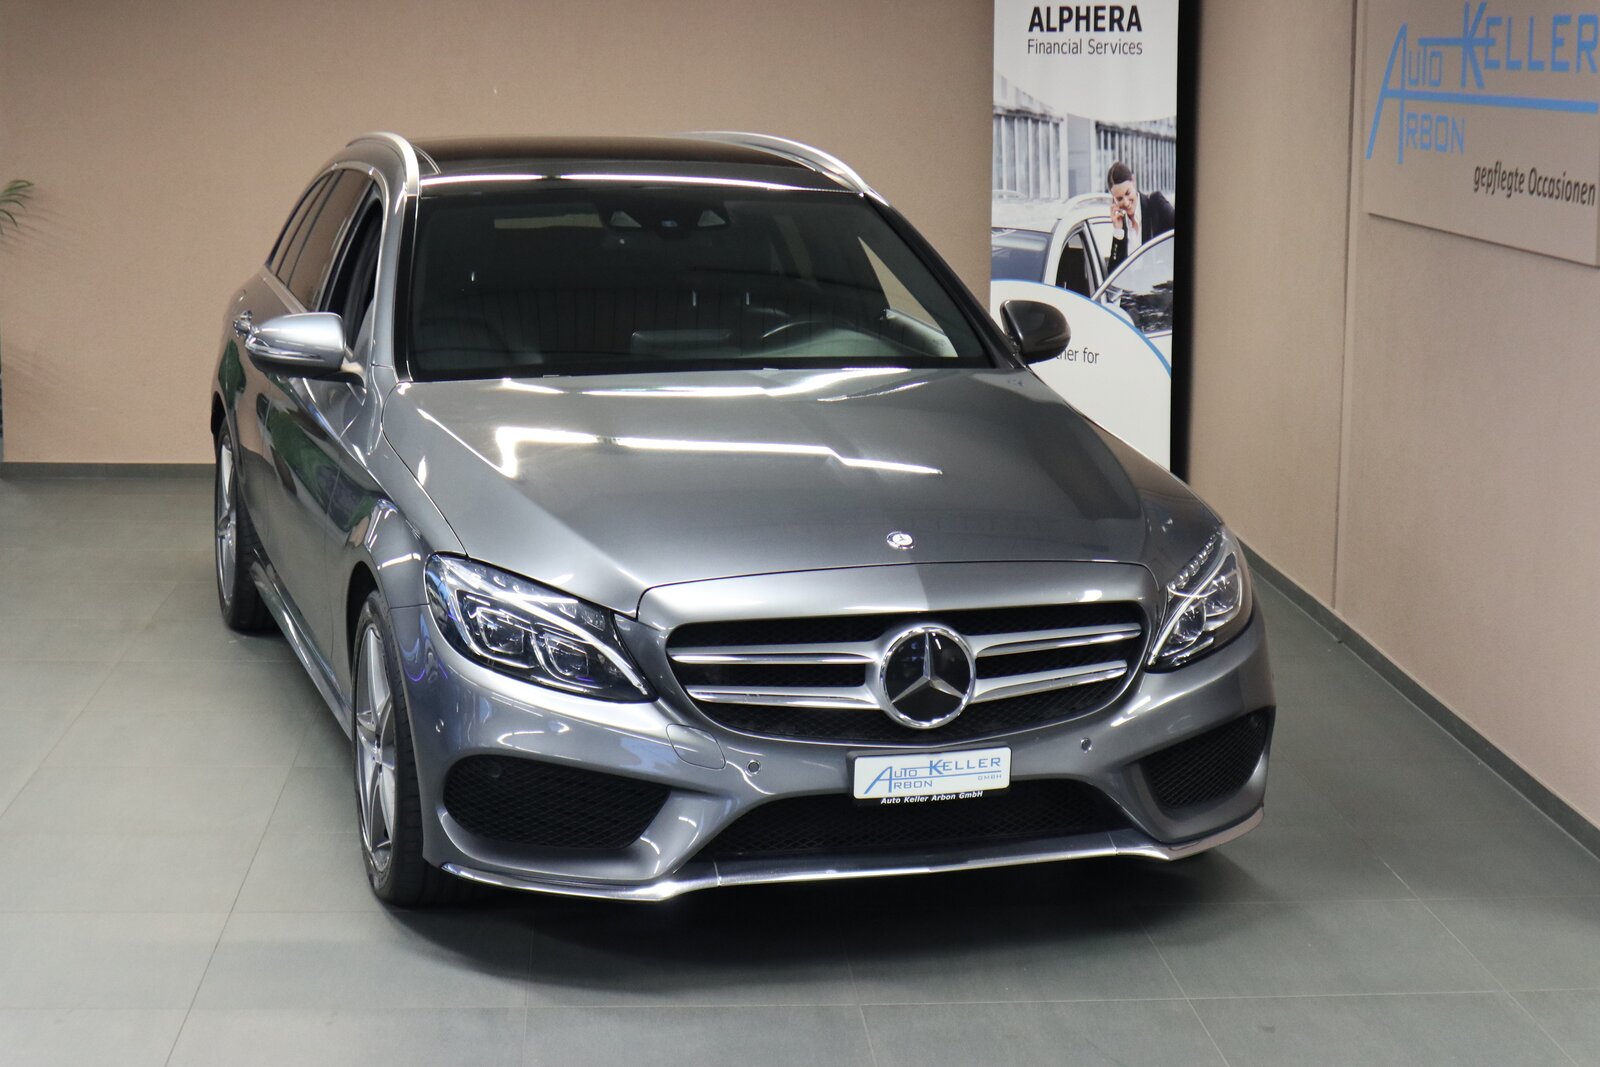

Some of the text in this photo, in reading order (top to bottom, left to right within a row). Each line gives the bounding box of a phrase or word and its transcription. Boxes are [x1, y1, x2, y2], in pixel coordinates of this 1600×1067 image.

[1028, 5, 1142, 32] ALPHERA
[1027, 38, 1143, 55] Financial Services
[1473, 161, 1596, 206] gepflegte Occasionen
[1083, 347, 1100, 364] for
[880, 790, 984, 805] Auto Keller Arbon GmbH
